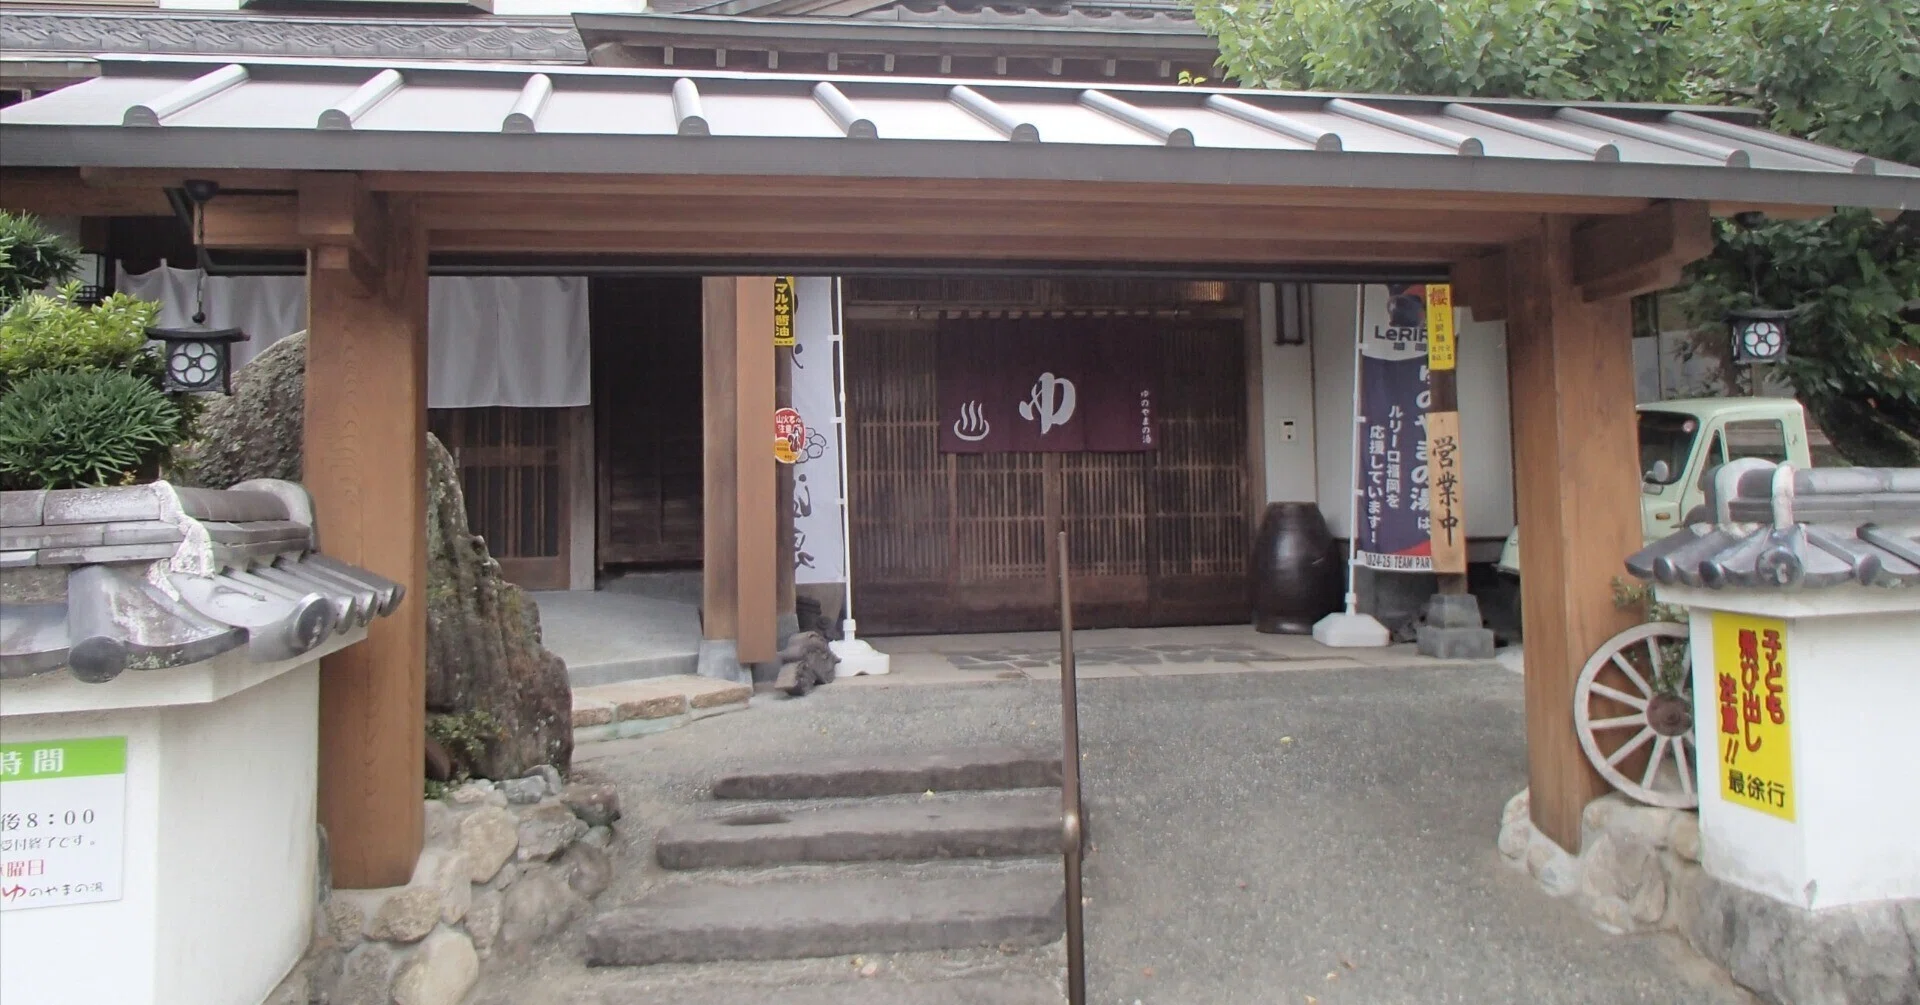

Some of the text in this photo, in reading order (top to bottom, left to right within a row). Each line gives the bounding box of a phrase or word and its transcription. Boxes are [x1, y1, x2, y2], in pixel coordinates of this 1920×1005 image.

[1018, 371, 1076, 435] ゆ
[1432, 435, 1459, 547] 営業中
[1394, 555, 1413, 569] TEAM
[1738, 628, 1762, 753] 飛び出し
[1761, 628, 1785, 725] 子ども
[0, 747, 65, 776] 時間
[1728, 768, 1785, 808] 最徐行
[0, 859, 45, 879] 曜日
